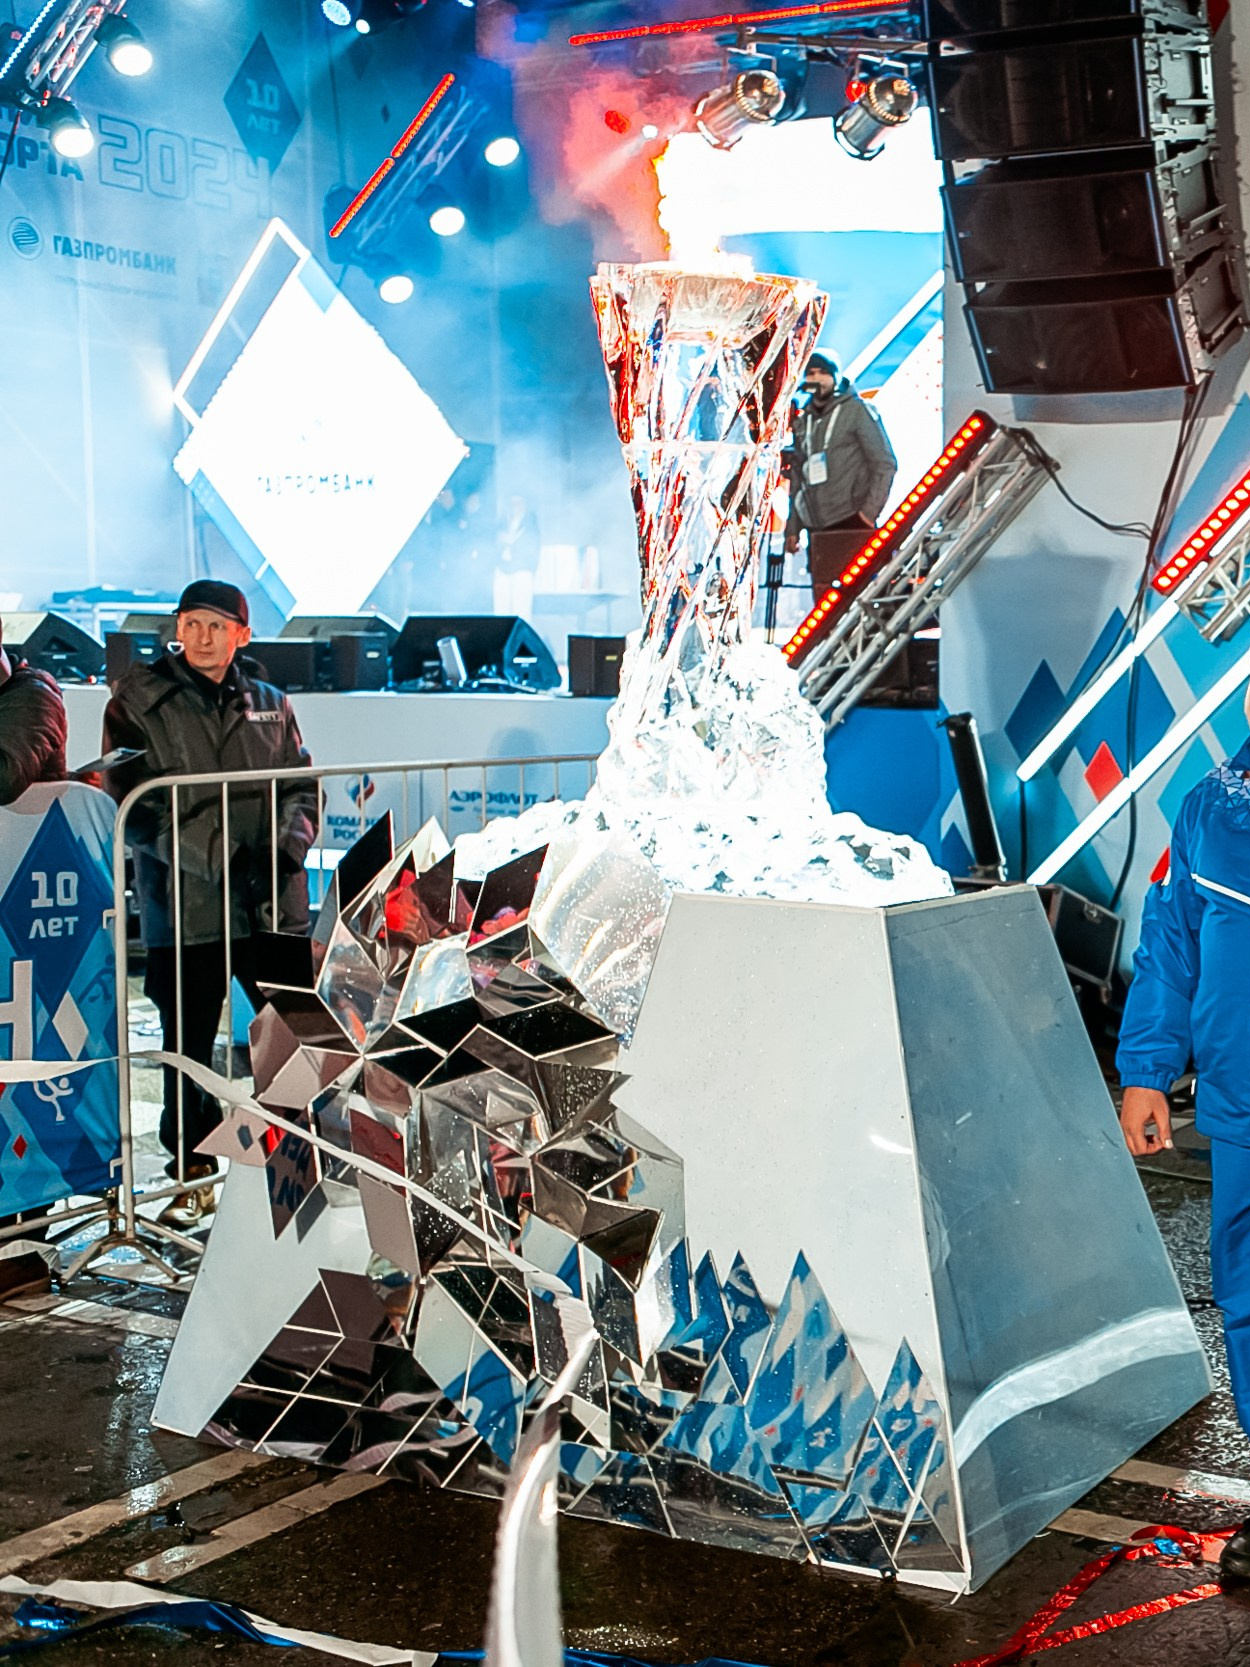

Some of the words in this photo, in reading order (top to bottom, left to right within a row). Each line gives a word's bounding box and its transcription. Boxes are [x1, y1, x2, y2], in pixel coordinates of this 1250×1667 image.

[97, 113, 273, 219] 2024
[53, 235, 177, 275] ГАЗПРОМБАНК
[31, 871, 79, 908] 10
